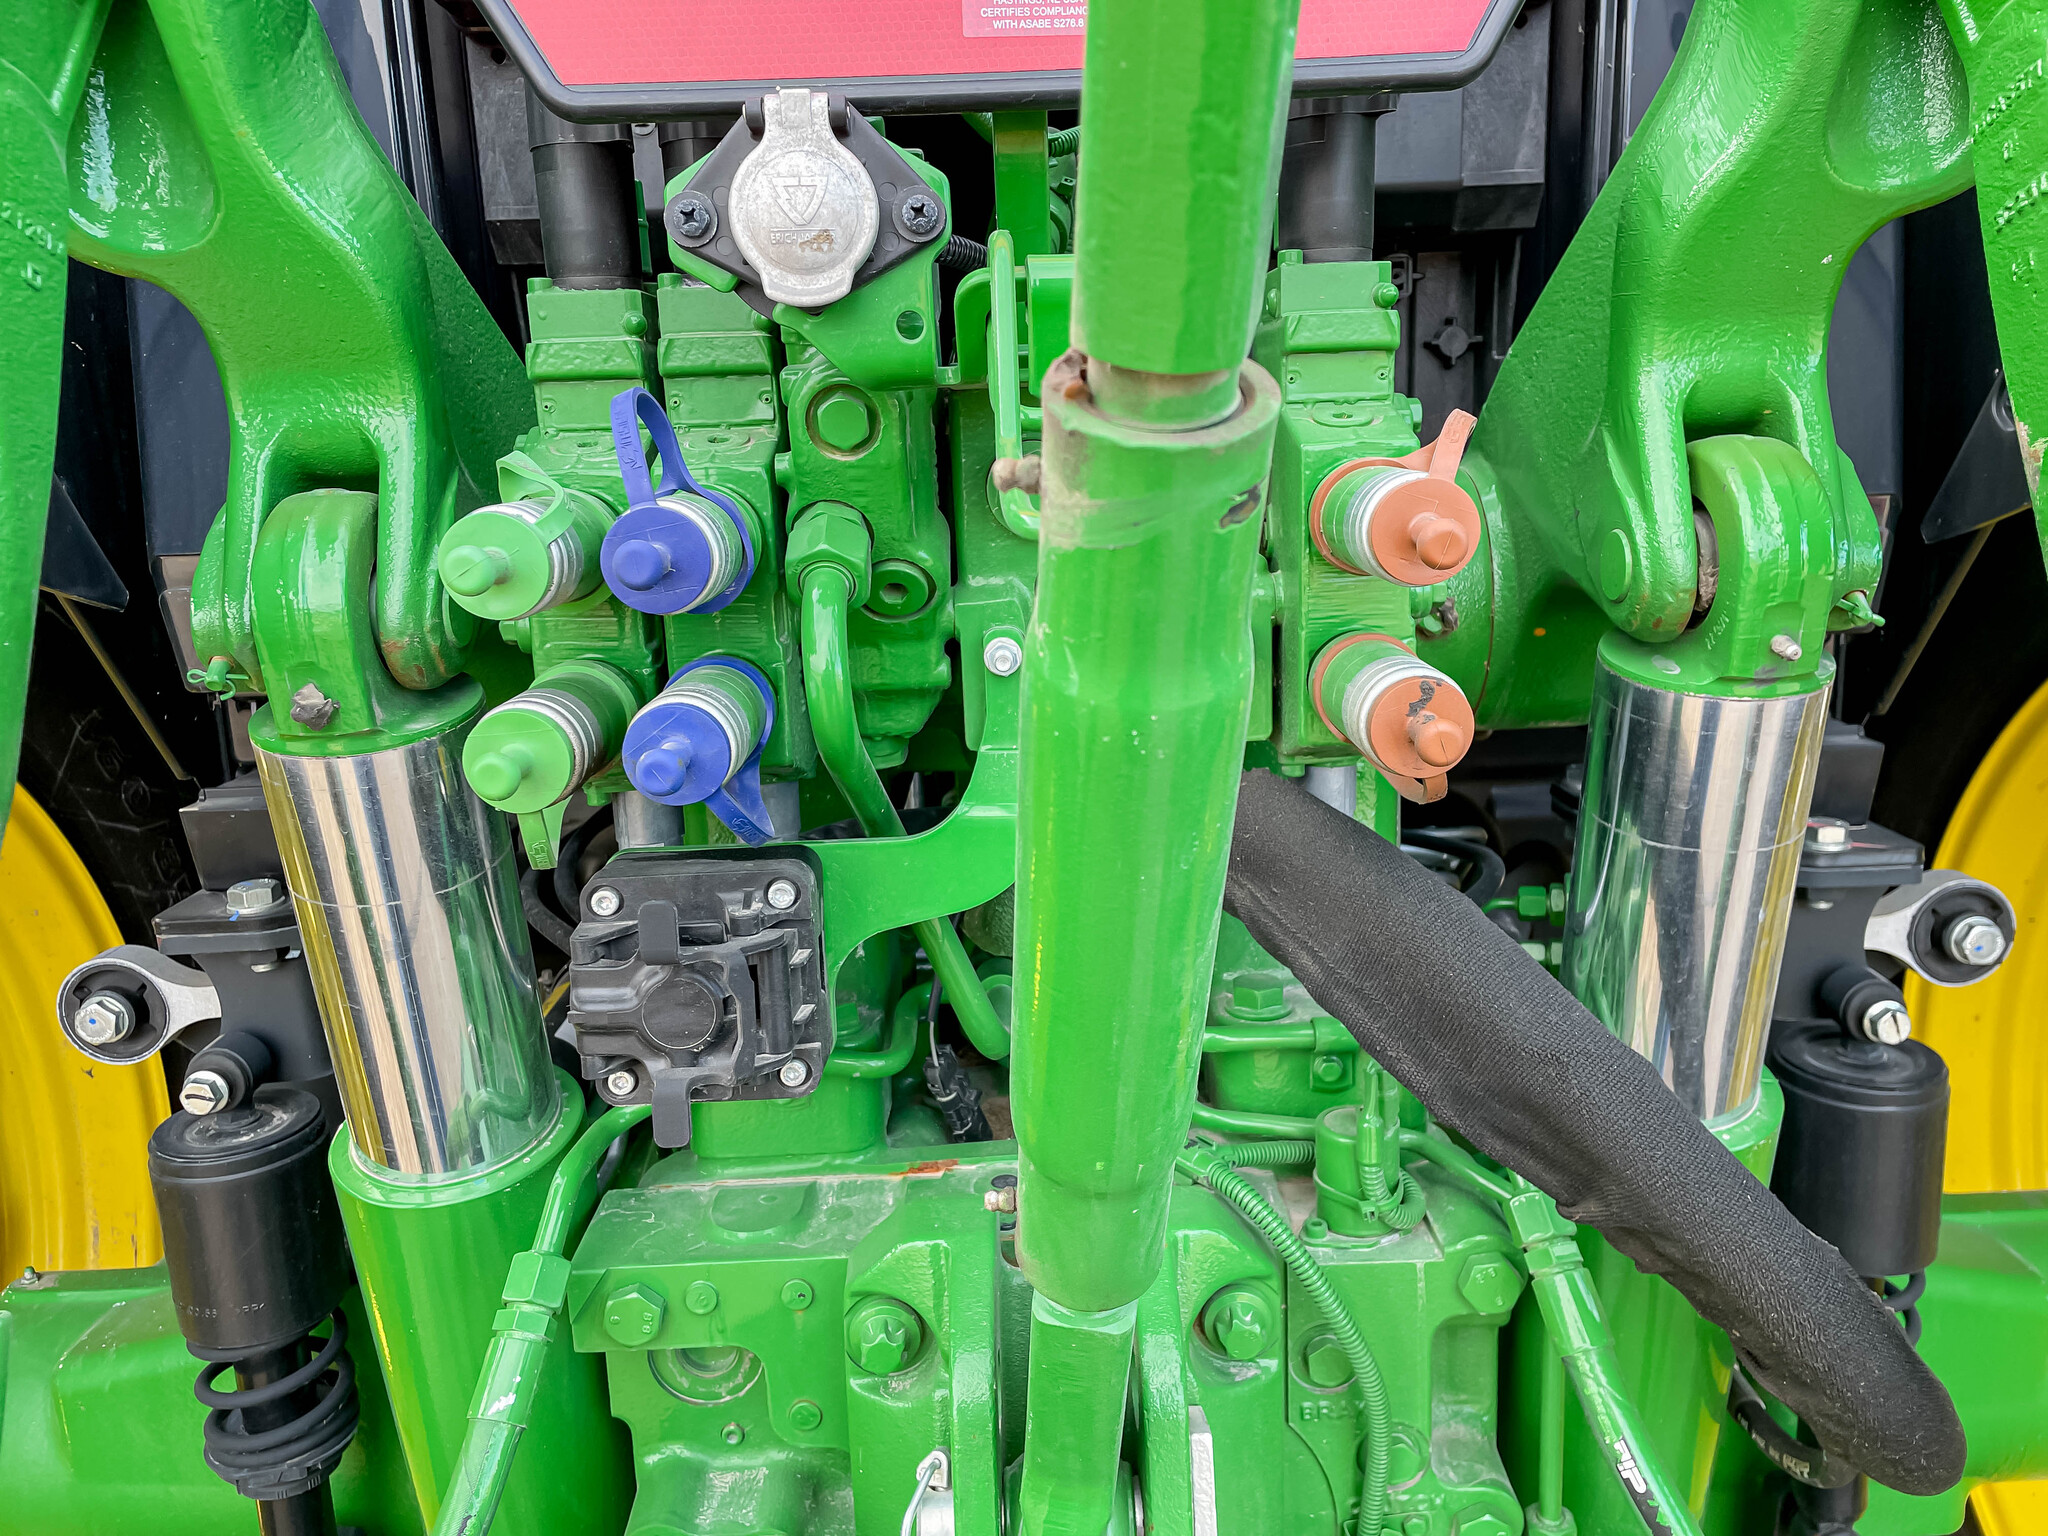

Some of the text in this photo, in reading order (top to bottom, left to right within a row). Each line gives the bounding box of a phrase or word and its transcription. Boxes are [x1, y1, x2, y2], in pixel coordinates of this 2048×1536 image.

[981, 7, 1031, 18] CERTIFIES
[993, 20, 1018, 29] WITH
[1019, 19, 1052, 28] ASABE
[770, 232, 797, 244] ERICH
